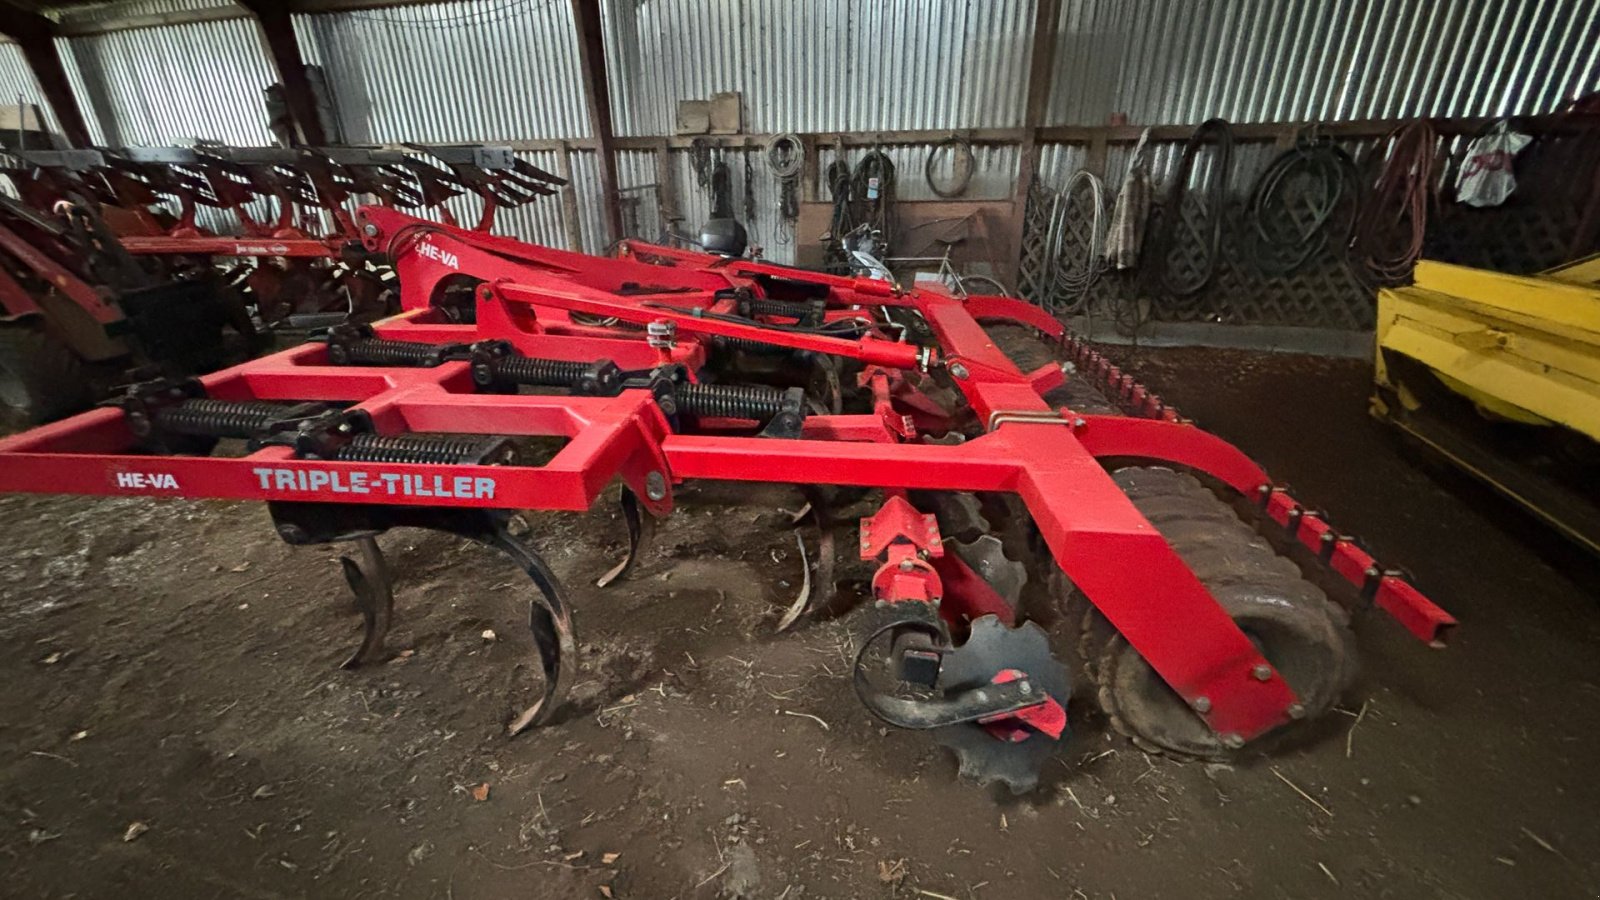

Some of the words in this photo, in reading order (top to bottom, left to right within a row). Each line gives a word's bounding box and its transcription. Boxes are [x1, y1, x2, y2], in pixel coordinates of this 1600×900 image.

[420, 242, 459, 270] HE-VA
[116, 472, 180, 489] HE-VA
[253, 468, 496, 499] TRIPLE-TILLER
